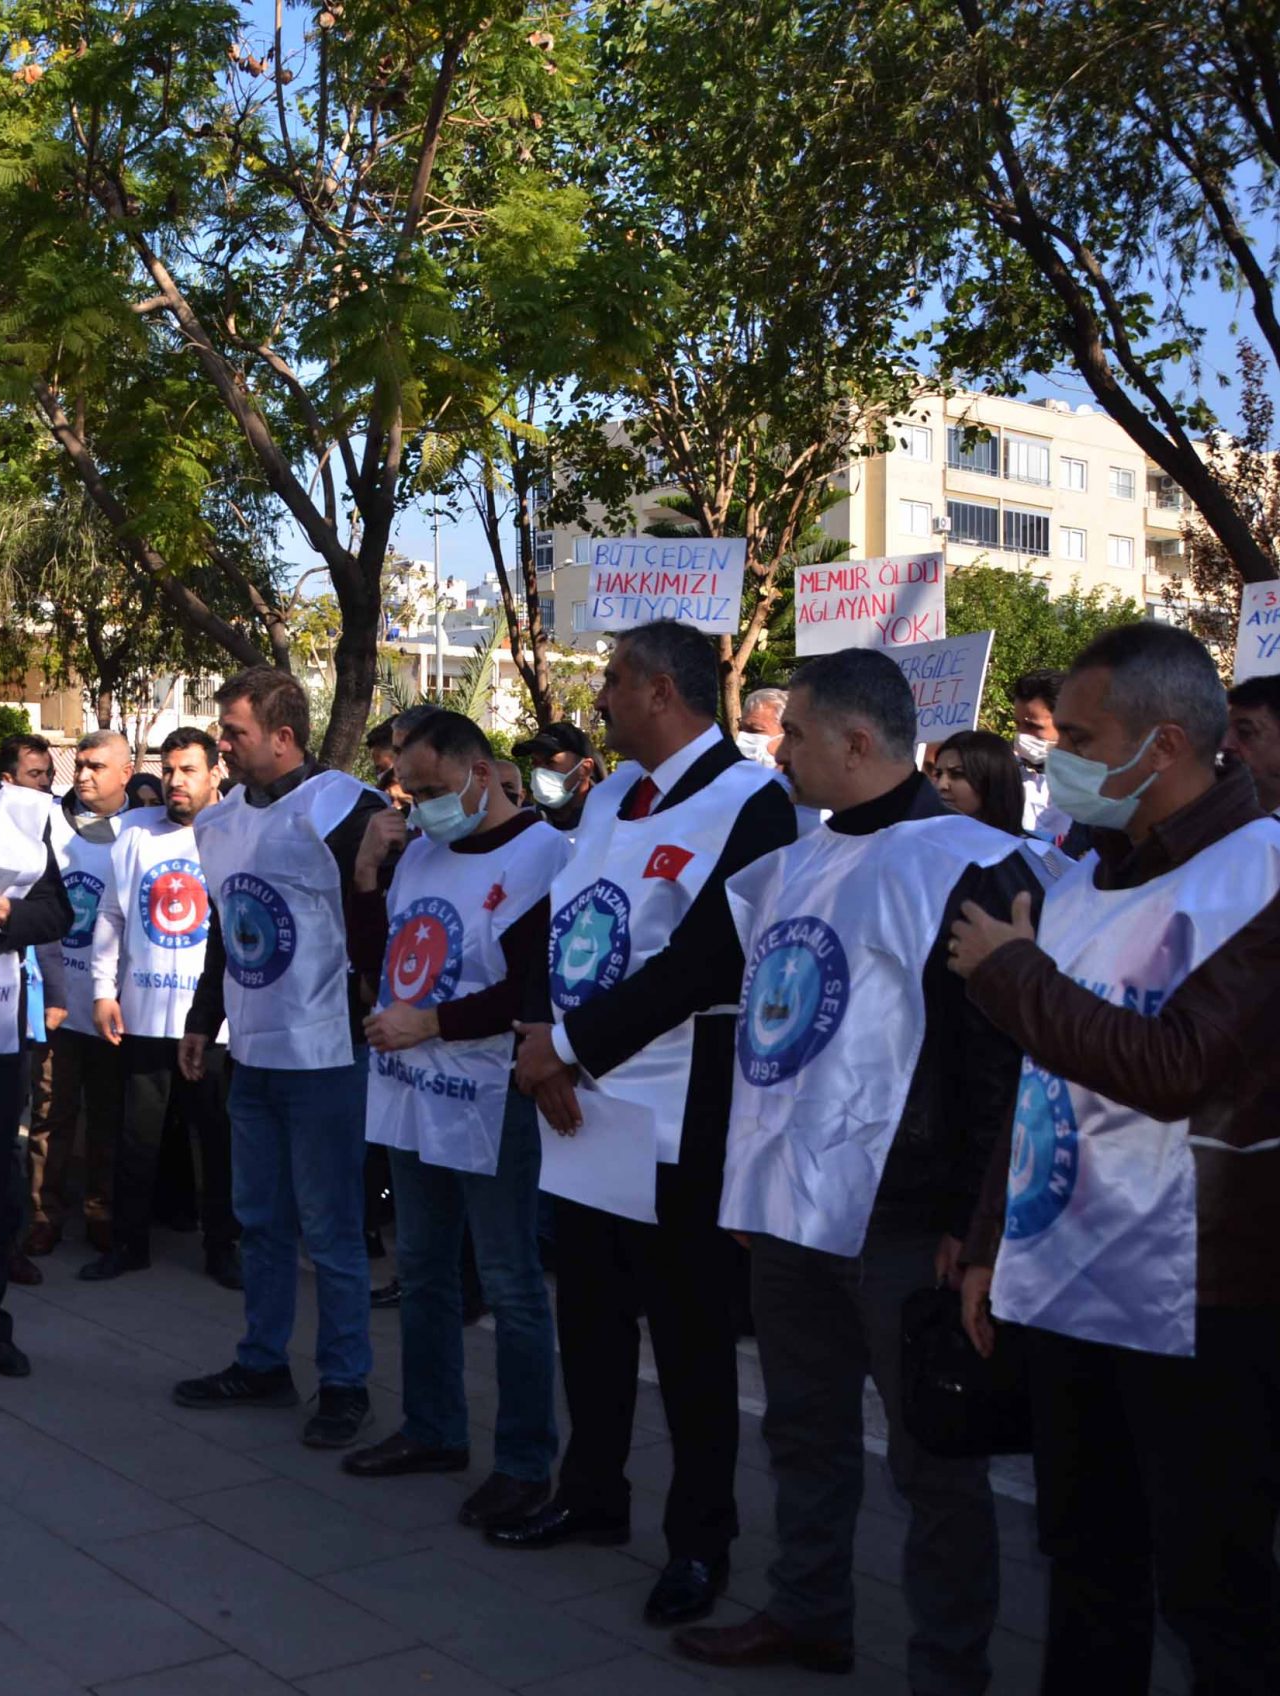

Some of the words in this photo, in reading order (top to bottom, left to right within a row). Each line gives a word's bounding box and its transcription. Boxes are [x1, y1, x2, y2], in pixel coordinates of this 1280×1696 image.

[596, 543, 732, 571] BÜTÇEDEN
[596, 572, 718, 595] HAKKIMIZI
[800, 566, 870, 594] MEMUR
[878, 559, 939, 586] ÖLDÜ
[592, 595, 731, 621] İSTİYORUZ
[799, 592, 896, 624] AĞLAYANI
[814, 978, 842, 1033] SEN
